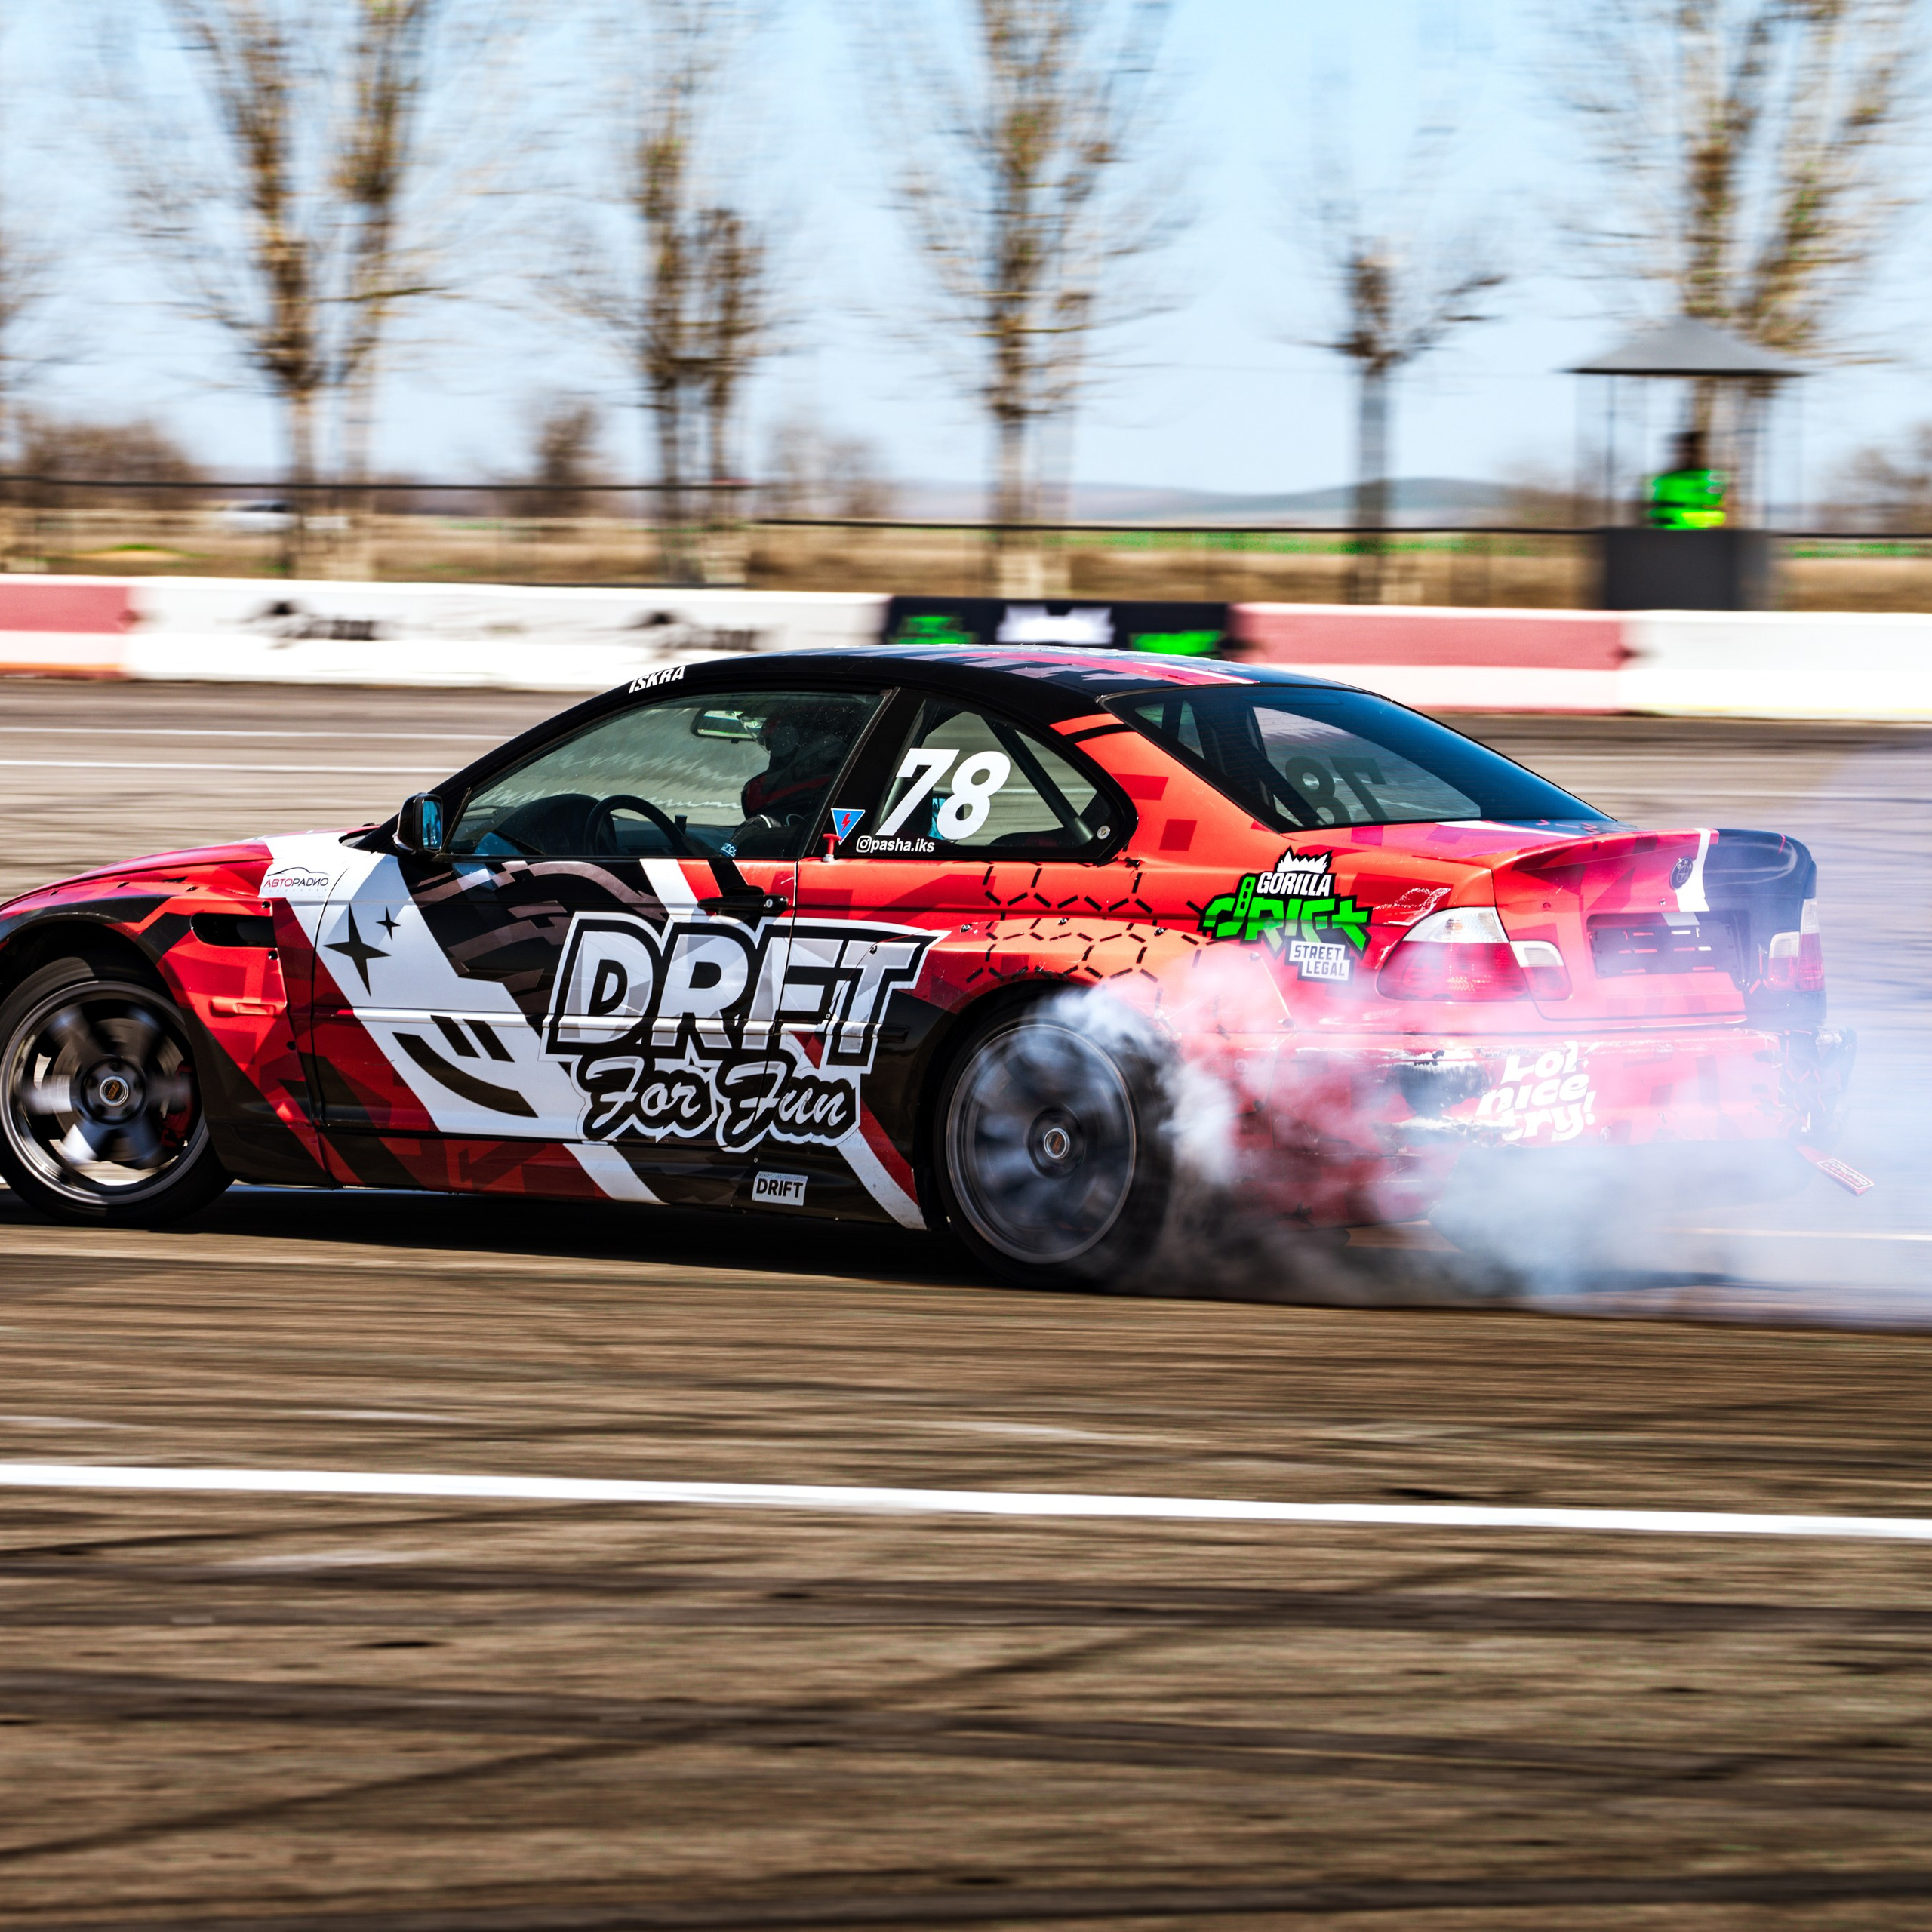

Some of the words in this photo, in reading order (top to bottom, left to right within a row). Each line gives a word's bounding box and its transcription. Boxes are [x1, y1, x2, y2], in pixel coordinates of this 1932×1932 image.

[875, 748, 1011, 840] 78
[1256, 872, 1332, 897] GORILLA
[1294, 944, 1342, 961] STREET
[1306, 961, 1346, 977] LEGAL
[583, 1057, 702, 1130] For
[723, 1058, 848, 1137] Fun
[1475, 1073, 1590, 1115] nice
[756, 1178, 804, 1198] DRIFT
